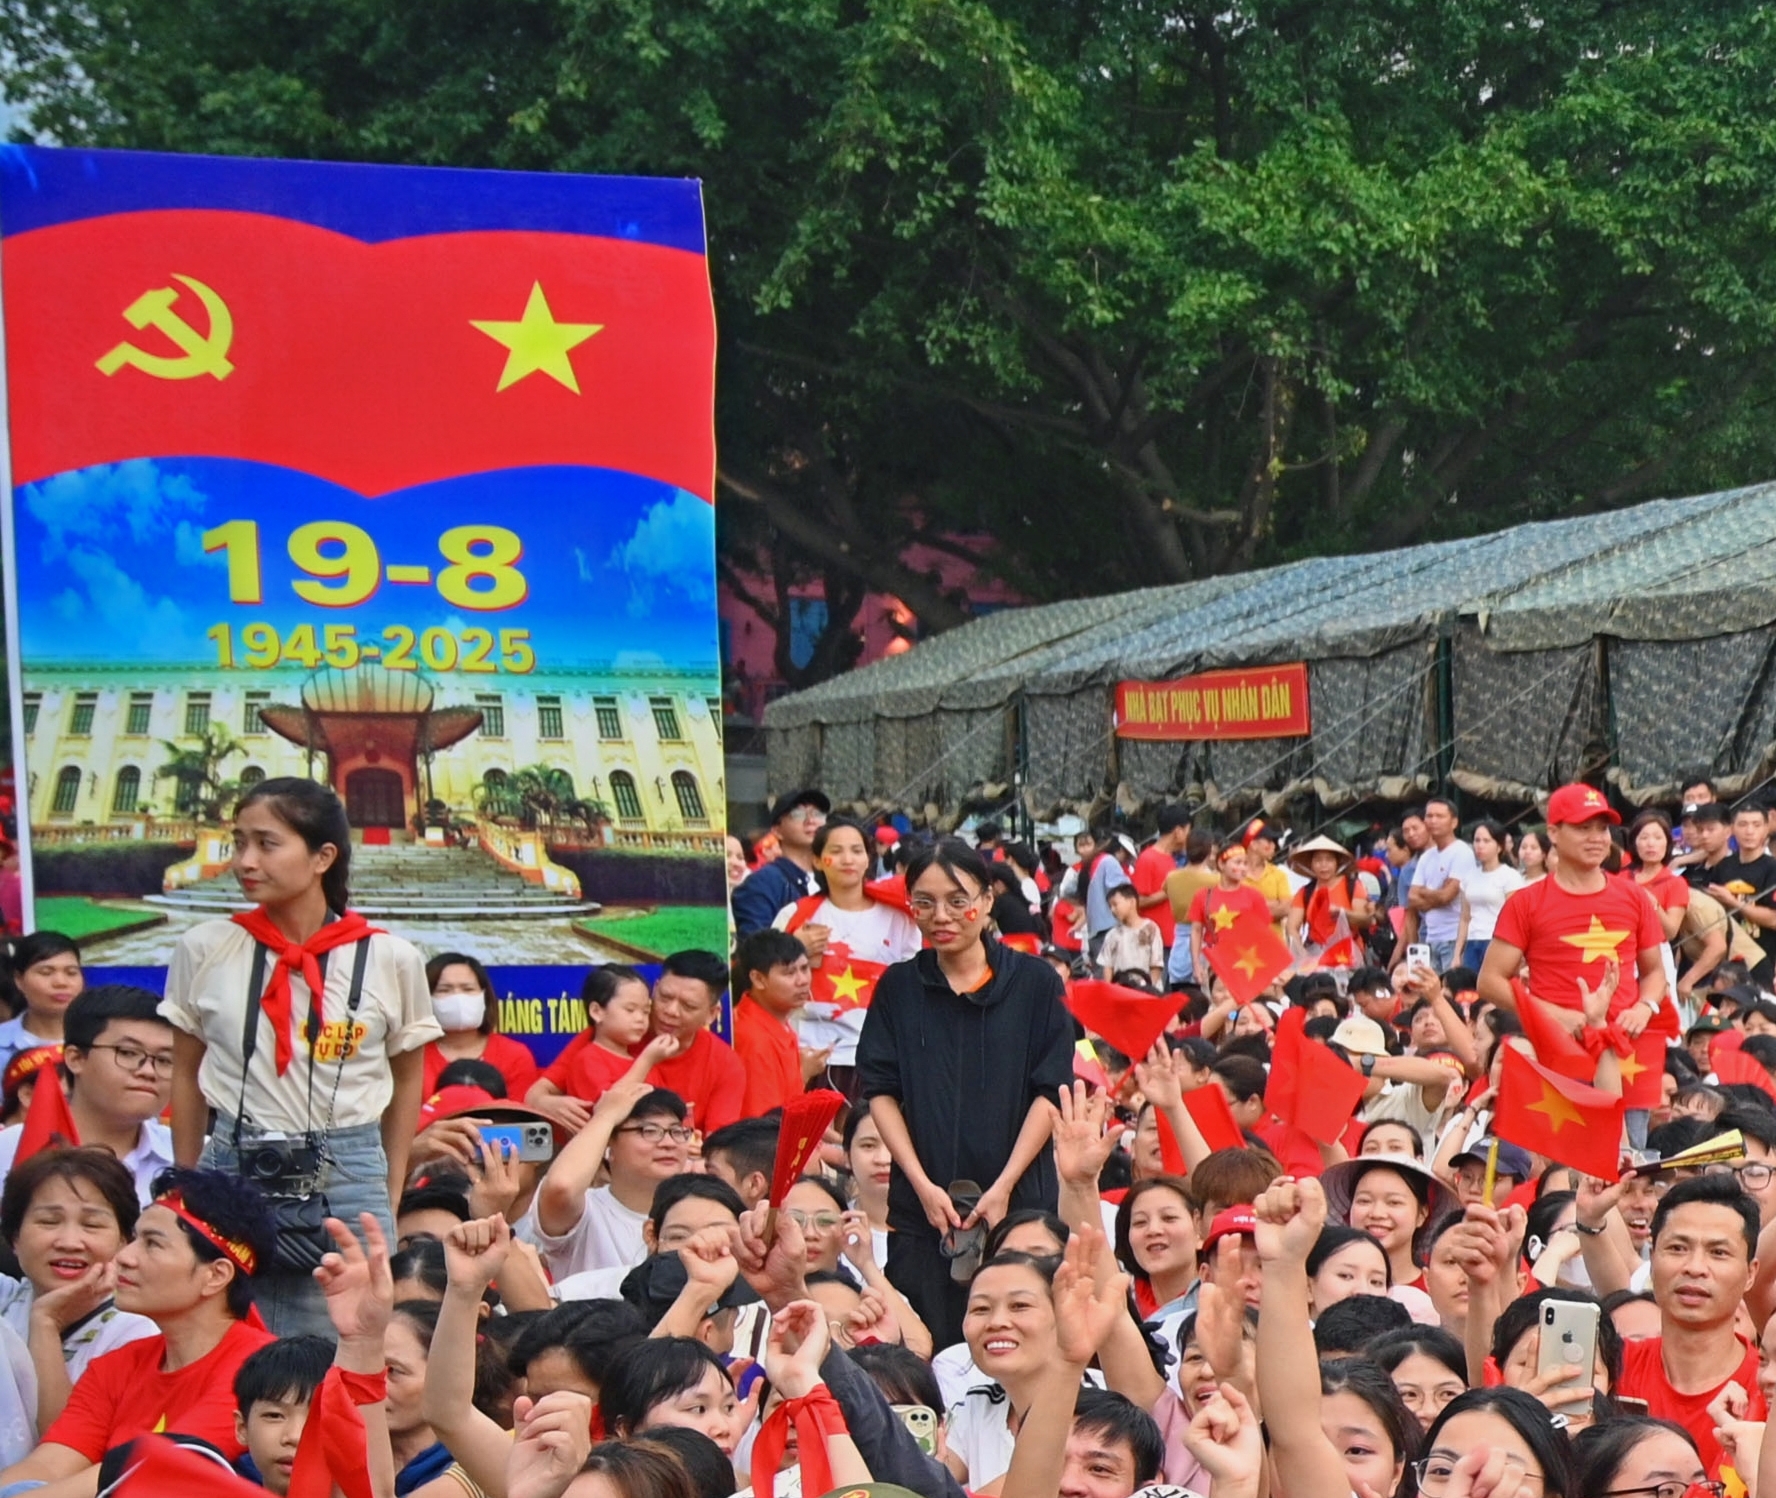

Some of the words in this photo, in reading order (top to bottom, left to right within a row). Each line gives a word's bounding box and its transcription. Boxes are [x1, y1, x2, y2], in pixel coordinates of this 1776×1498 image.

[201, 520, 531, 612] 19-8
[207, 623, 536, 675] 1945-2025
[1125, 684, 1148, 723] NHÀ
[1171, 689, 1202, 731] PHỤC
[1203, 688, 1219, 731] VỤ
[1221, 679, 1259, 723] NHÂN
[1261, 675, 1292, 720] DÂN
